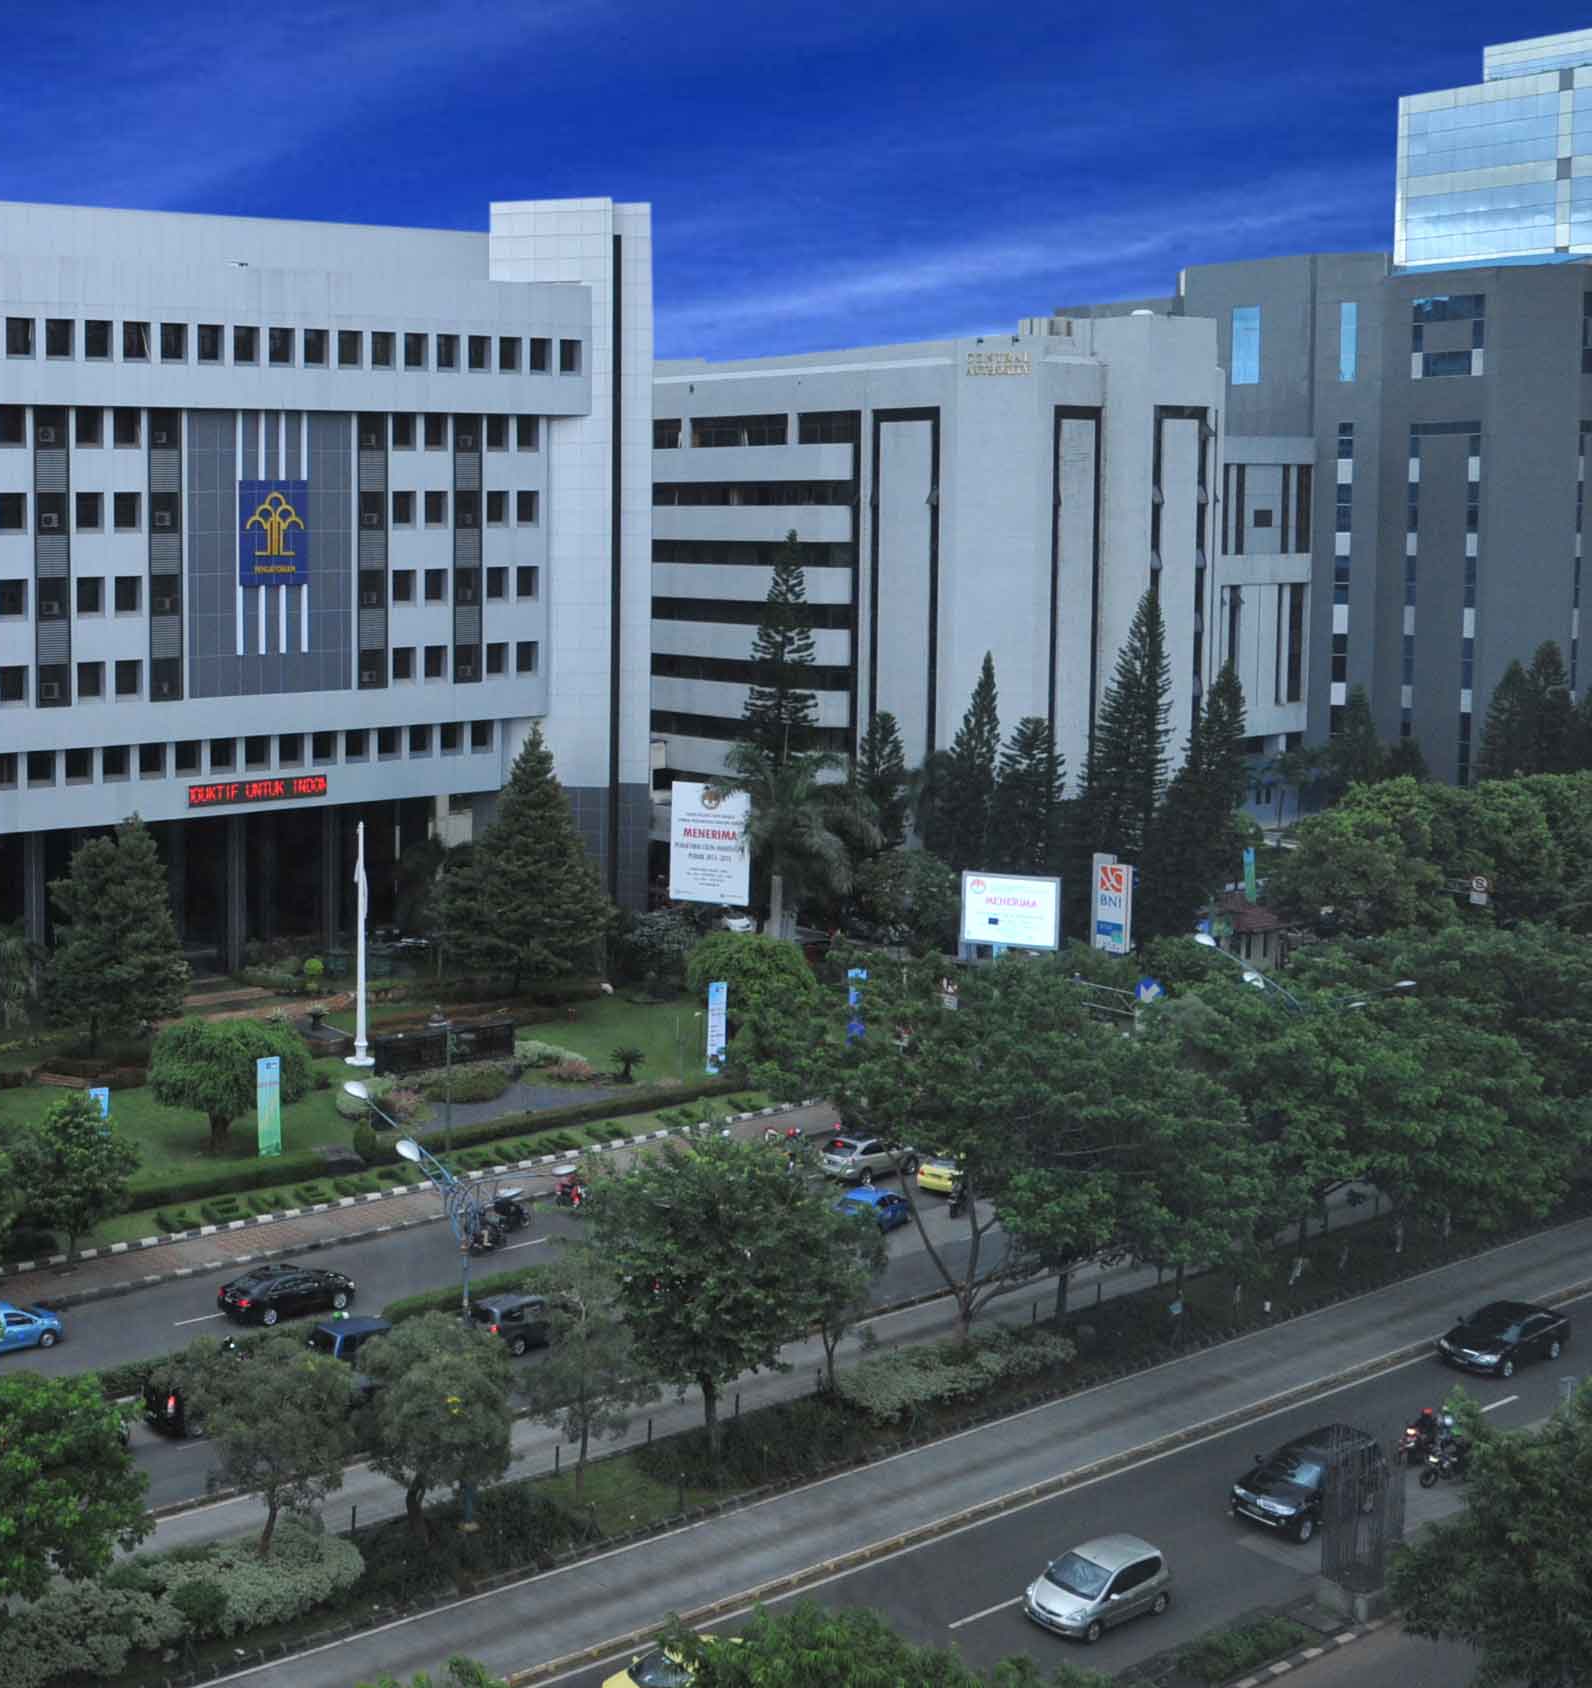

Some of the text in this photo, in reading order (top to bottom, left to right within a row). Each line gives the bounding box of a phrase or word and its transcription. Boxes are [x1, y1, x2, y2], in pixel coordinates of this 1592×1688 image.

[245, 780, 285, 799] UNTUK
[683, 827, 738, 841] MENERIMA
[1100, 894, 1121, 909] BNI
